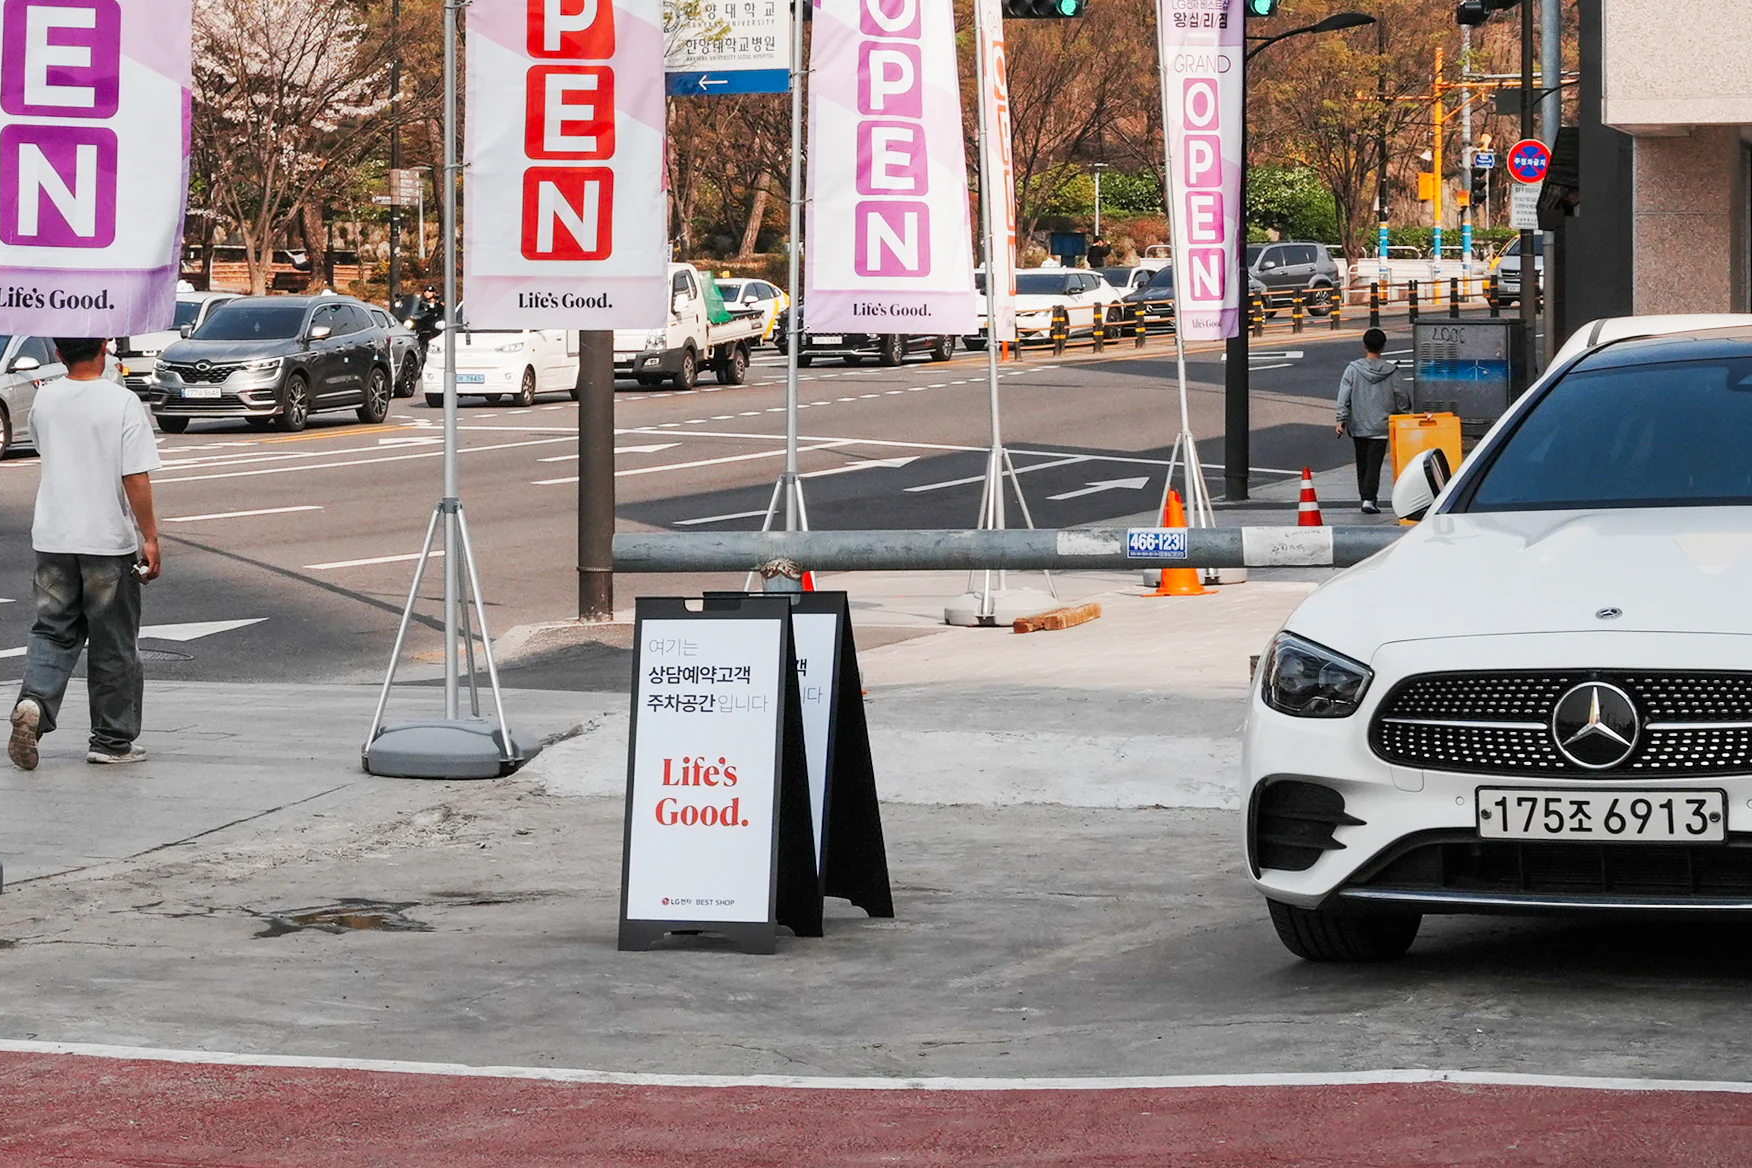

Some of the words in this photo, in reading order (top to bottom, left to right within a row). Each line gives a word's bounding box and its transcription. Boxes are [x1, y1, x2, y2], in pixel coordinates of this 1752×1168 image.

[1174, 54, 1232, 74] GRAND
[1185, 82, 1221, 298] OPEN
[49, 287, 115, 310] Good.
[518, 292, 558, 310] Life's
[562, 292, 613, 310] Good.
[853, 302, 887, 317] Life's
[890, 303, 931, 318] Good.
[1131, 533, 1184, 551] 466-1231
[648, 638, 698, 657] 여기는
[648, 665, 751, 684] 상담예약고객
[662, 756, 738, 787] Life's
[655, 797, 749, 827] Good.
[1494, 796, 1593, 833] 175조
[1604, 798, 1708, 834] 6913
[715, 899, 735, 907] SHOP
